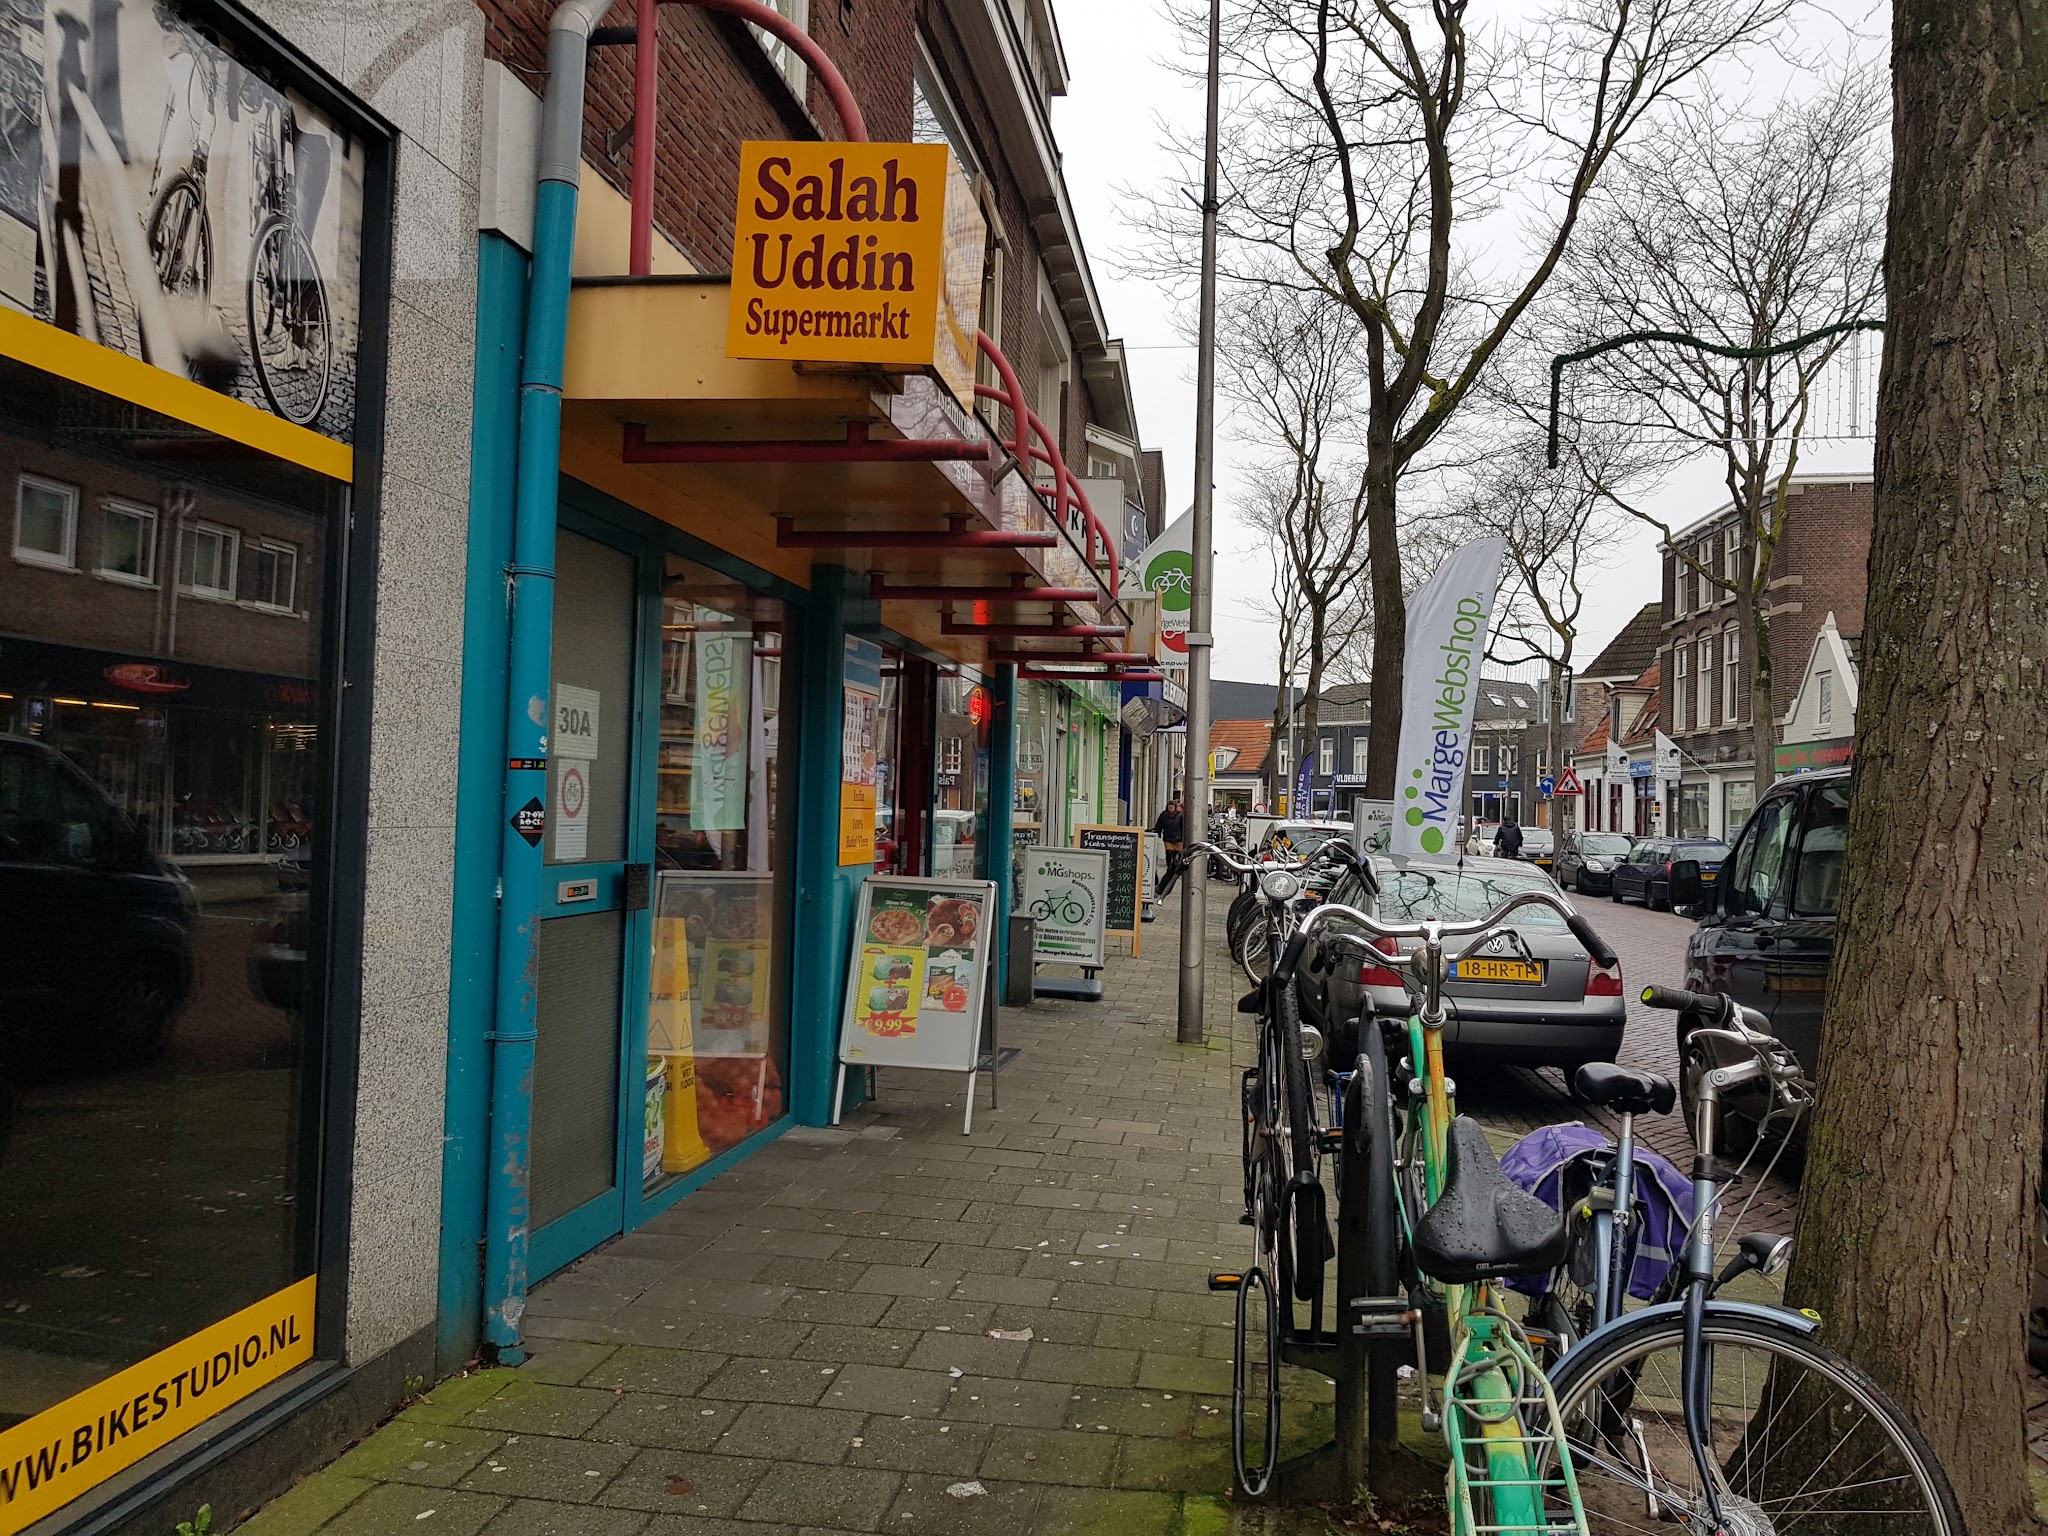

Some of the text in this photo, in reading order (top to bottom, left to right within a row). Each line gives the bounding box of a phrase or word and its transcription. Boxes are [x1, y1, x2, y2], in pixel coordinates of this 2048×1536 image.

[754, 156, 919, 222] Salah
[752, 232, 915, 292] Uddin
[745, 297, 910, 345] Supermarkt
[559, 706, 592, 737] 30A
[1084, 831, 1131, 842] Transport
